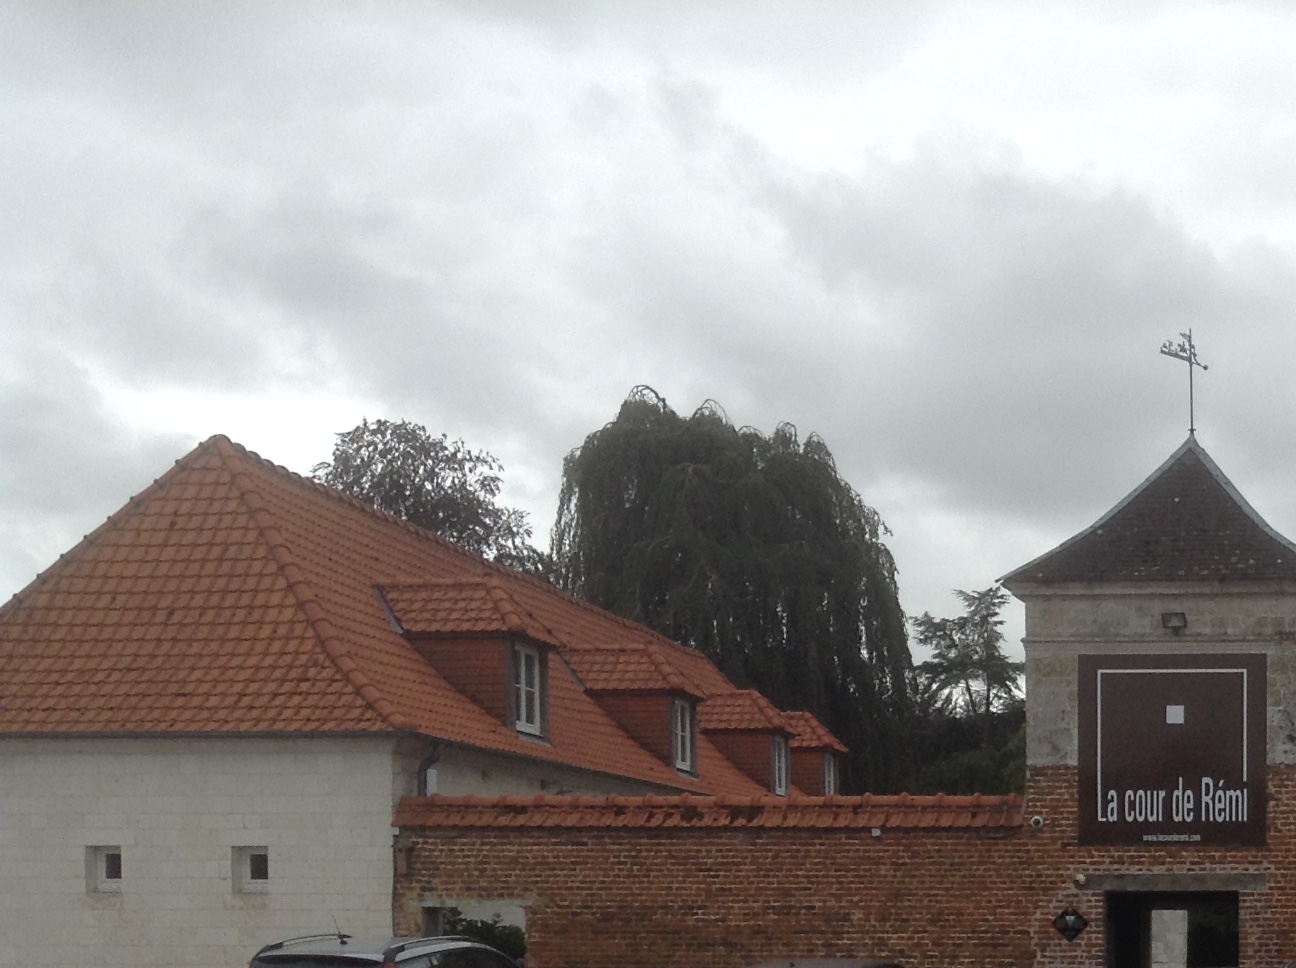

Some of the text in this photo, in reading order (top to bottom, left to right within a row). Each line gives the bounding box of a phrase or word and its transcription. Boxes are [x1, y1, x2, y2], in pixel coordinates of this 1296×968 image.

[1097, 776, 1248, 822] La cour de Rémi
